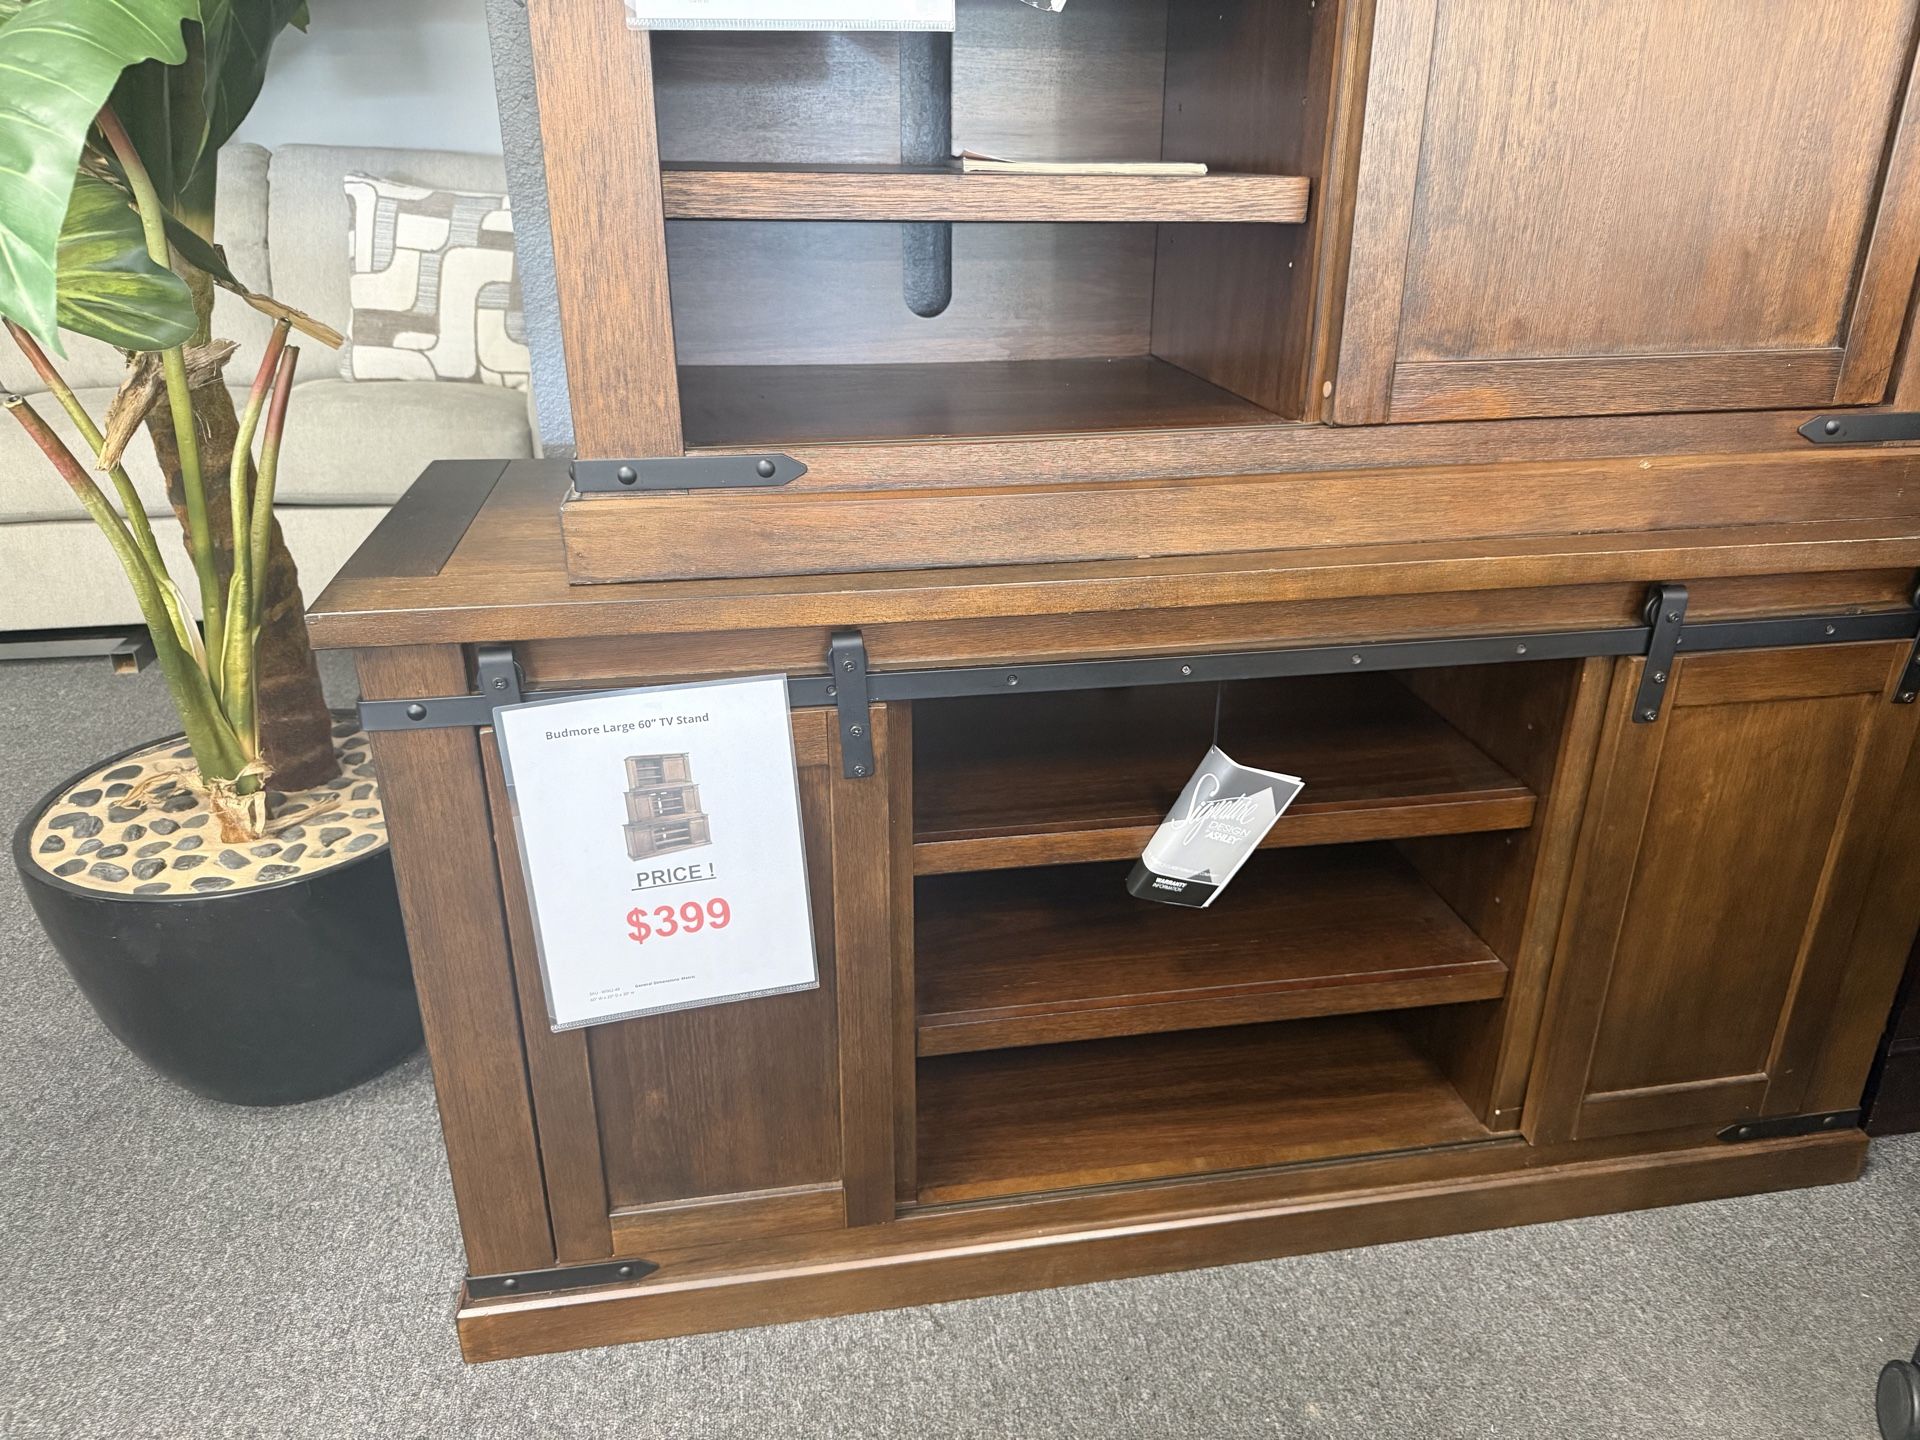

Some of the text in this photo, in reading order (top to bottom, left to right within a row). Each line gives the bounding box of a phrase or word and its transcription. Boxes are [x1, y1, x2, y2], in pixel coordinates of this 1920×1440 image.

[545, 726, 600, 740] Budmore
[603, 722, 635, 734] Large
[659, 716, 674, 727] TV
[676, 712, 709, 725] Stand
[1171, 773, 1258, 846] Signature
[1205, 830, 1243, 845] ASHLEY
[1208, 820, 1251, 837] DESIGN
[636, 864, 703, 887] PRICE
[1155, 876, 1188, 888] WARRANTY
[626, 897, 731, 945] $399
